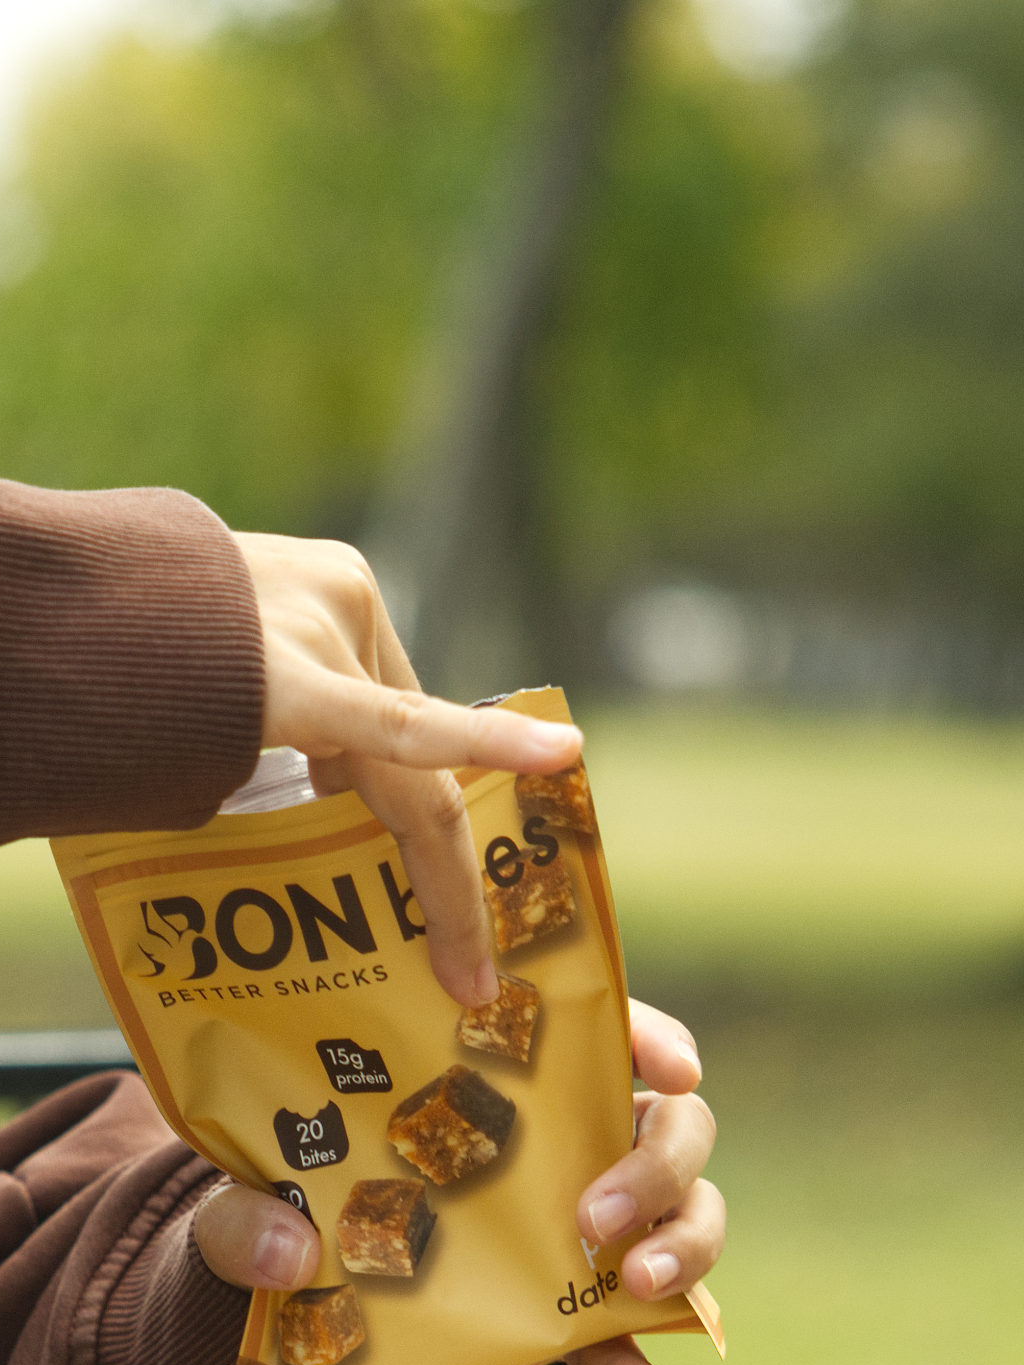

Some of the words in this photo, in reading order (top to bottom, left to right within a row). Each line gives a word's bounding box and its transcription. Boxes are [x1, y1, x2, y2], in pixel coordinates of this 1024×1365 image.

[137, 873, 378, 982] BON
[377, 815, 560, 942] bes
[157, 983, 265, 1009] BETTER
[274, 964, 389, 997] SNACKS
[326, 1047, 365, 1070] 15g
[335, 1069, 389, 1090] protein
[296, 1119, 324, 1144] 20
[299, 1148, 337, 1168] bites
[557, 1269, 618, 1316] date
